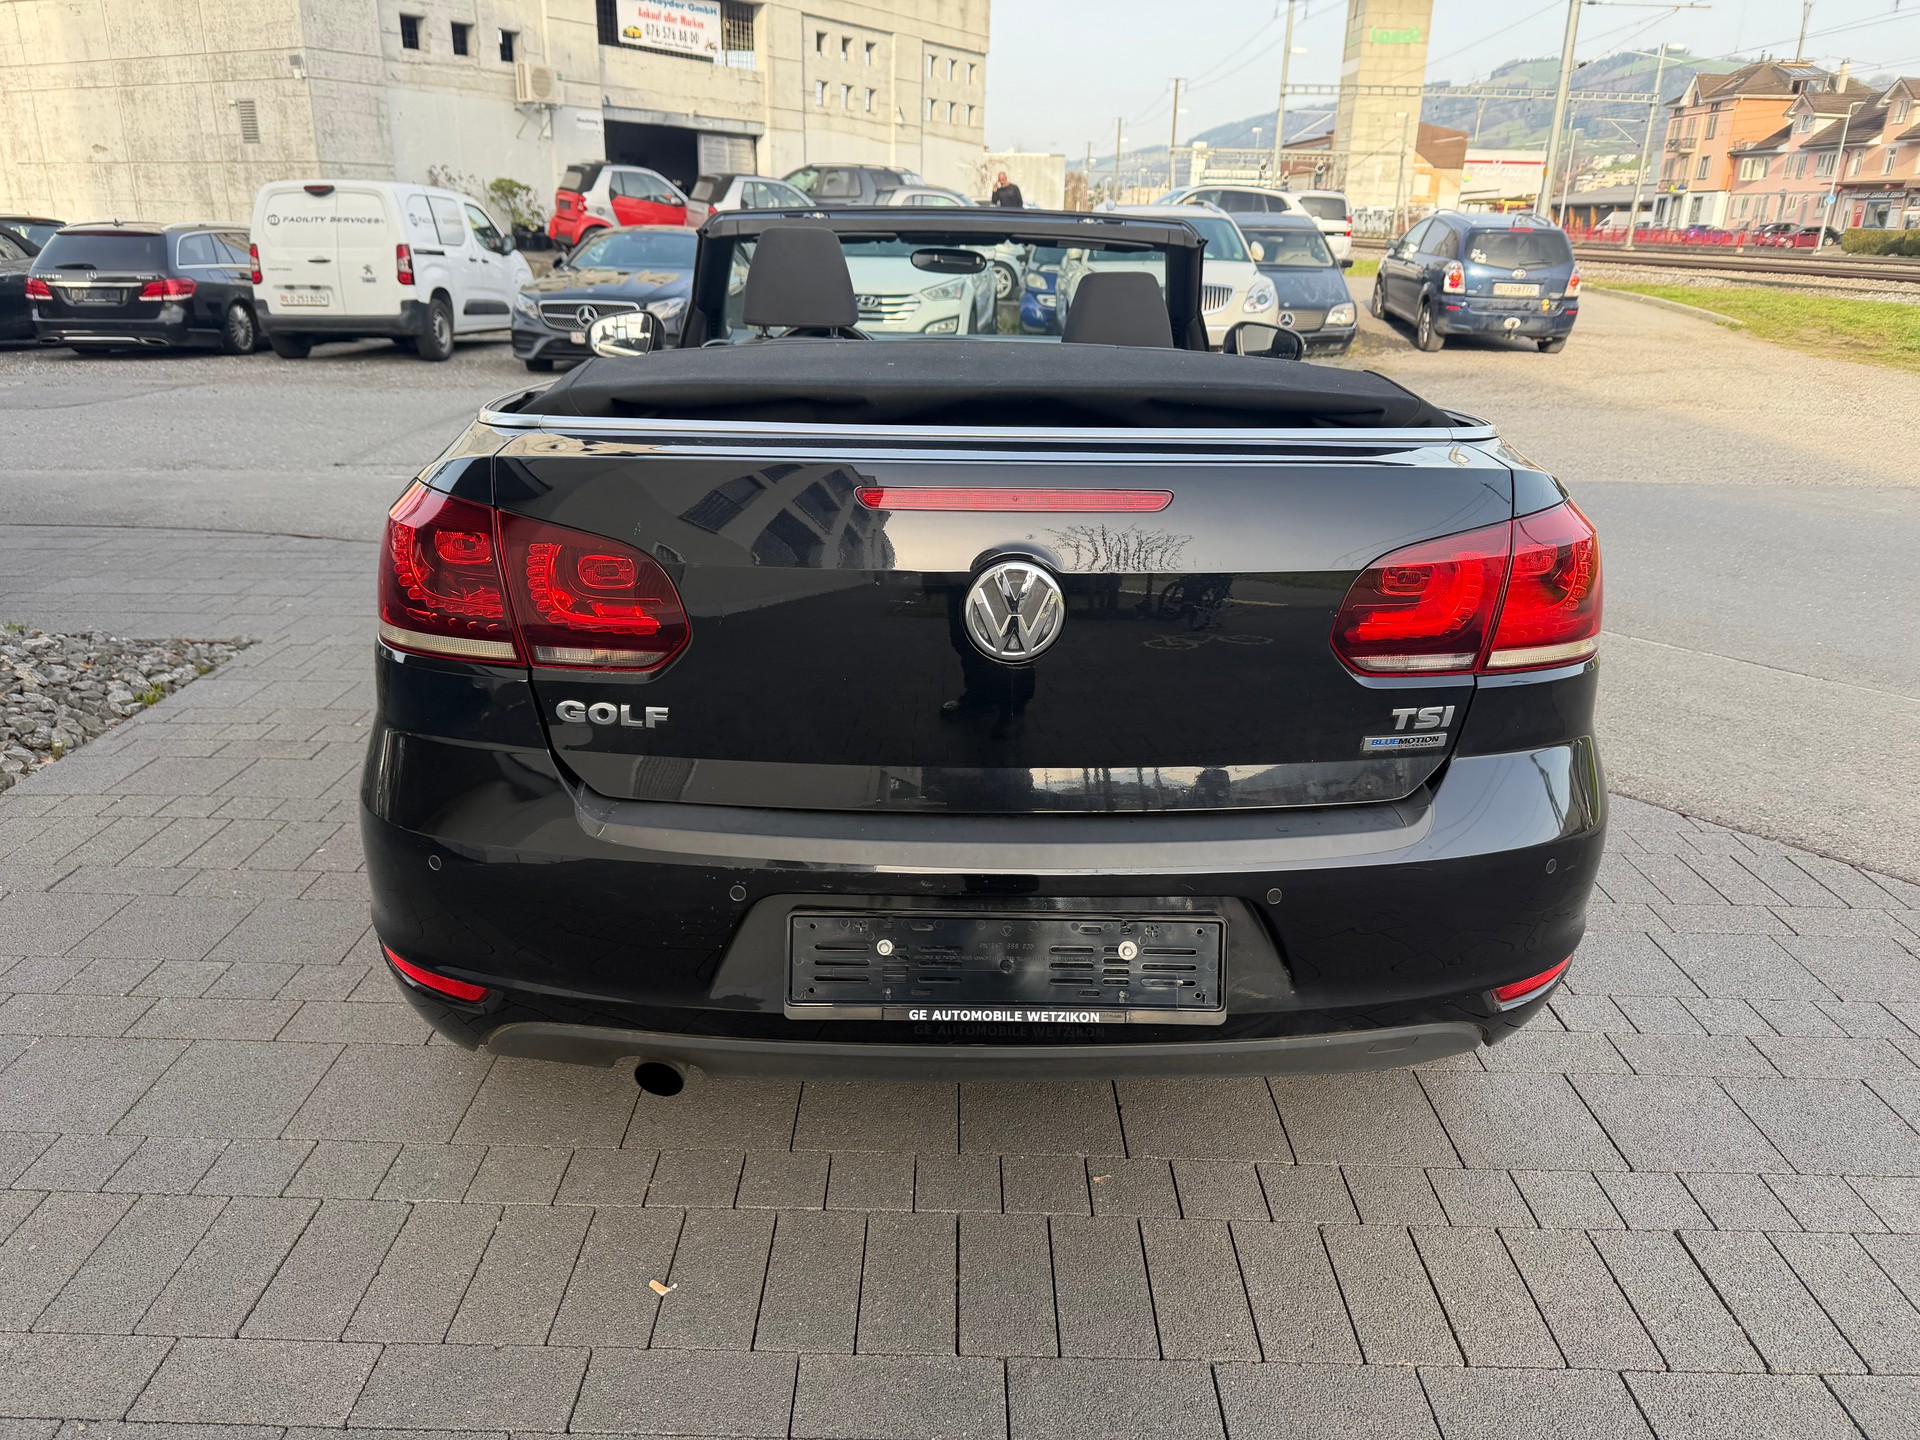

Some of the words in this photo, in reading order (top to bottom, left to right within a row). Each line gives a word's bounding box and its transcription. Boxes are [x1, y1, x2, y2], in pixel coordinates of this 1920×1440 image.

[688, 3, 718, 16] GmbH
[283, 216, 327, 224] FACILITY
[329, 216, 380, 224] SERVICES
[556, 700, 669, 728] GOLF
[1392, 705, 1455, 730] TSI
[1370, 735, 1440, 746] BLUEMOTION
[908, 1009, 928, 1021] GE
[931, 1010, 1023, 1022] AUTOMOBILE
[1026, 1010, 1100, 1023] WETZIKON
